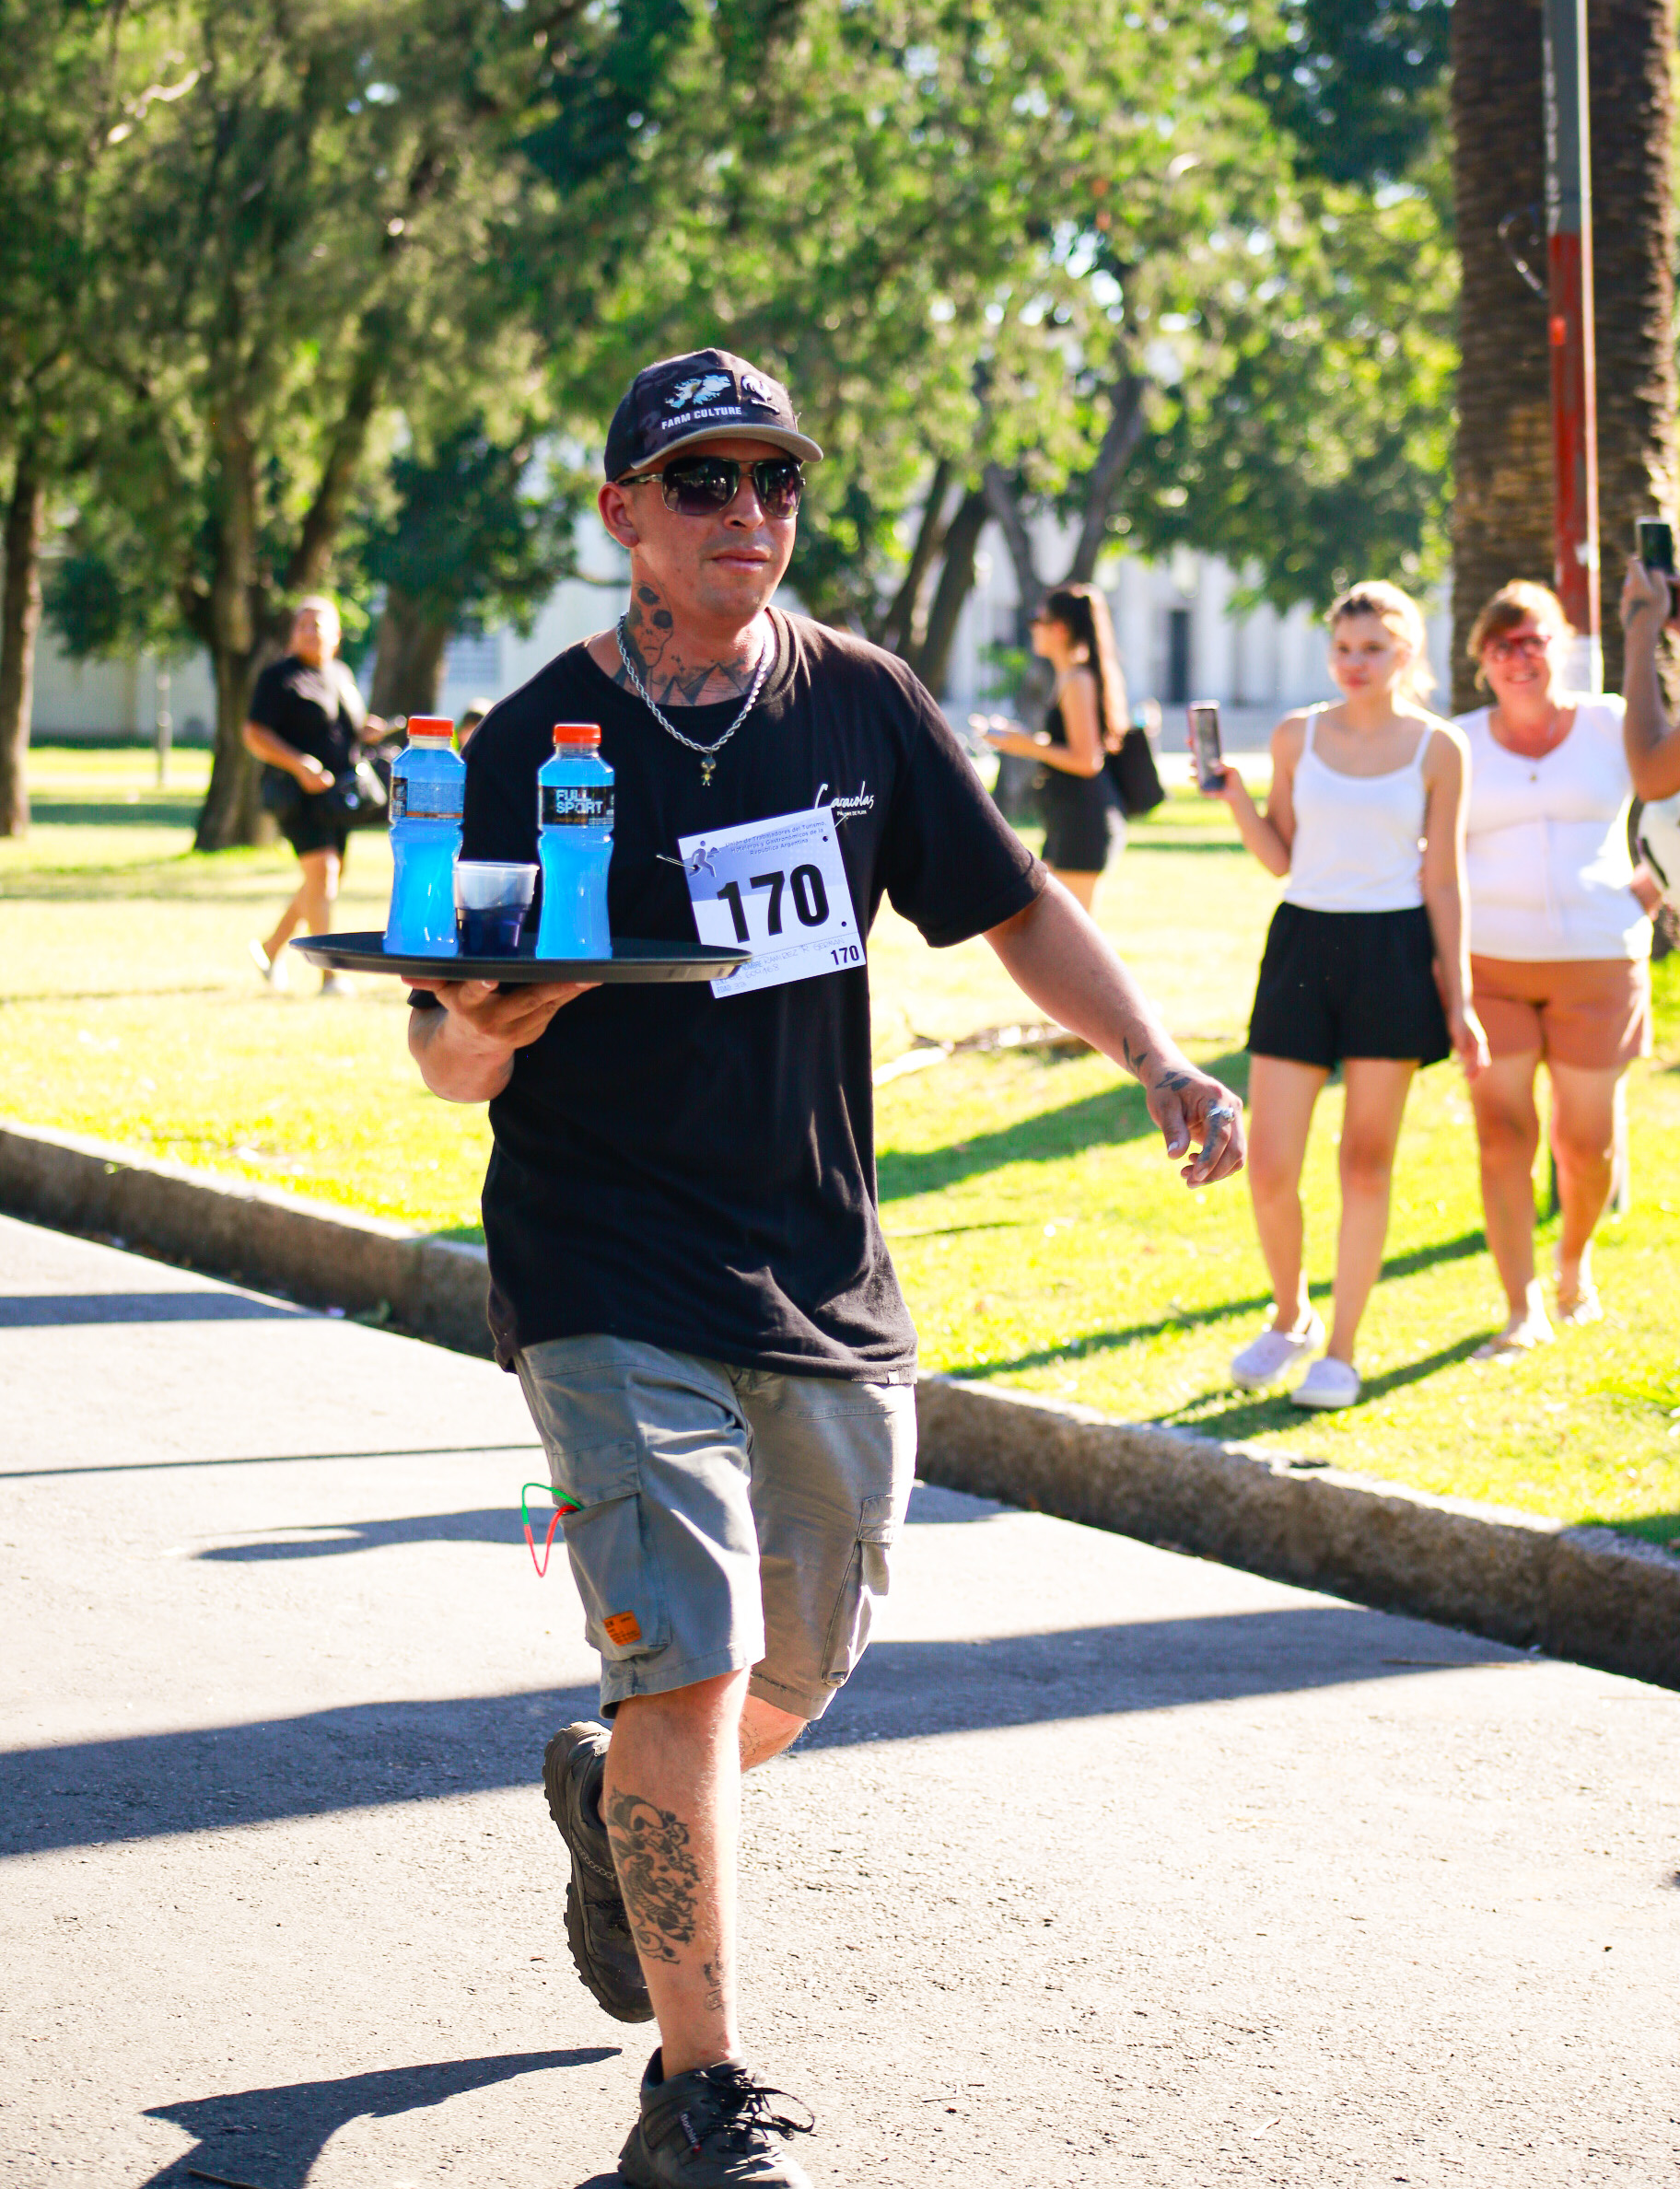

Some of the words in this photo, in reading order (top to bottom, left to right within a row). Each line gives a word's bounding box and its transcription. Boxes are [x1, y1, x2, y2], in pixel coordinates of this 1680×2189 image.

[661, 413, 691, 430] FARM
[694, 406, 742, 419] CULTURE
[555, 789, 592, 802] FULL
[555, 800, 603, 814] SPORT
[717, 864, 830, 943] 170
[831, 945, 859, 965] 170
